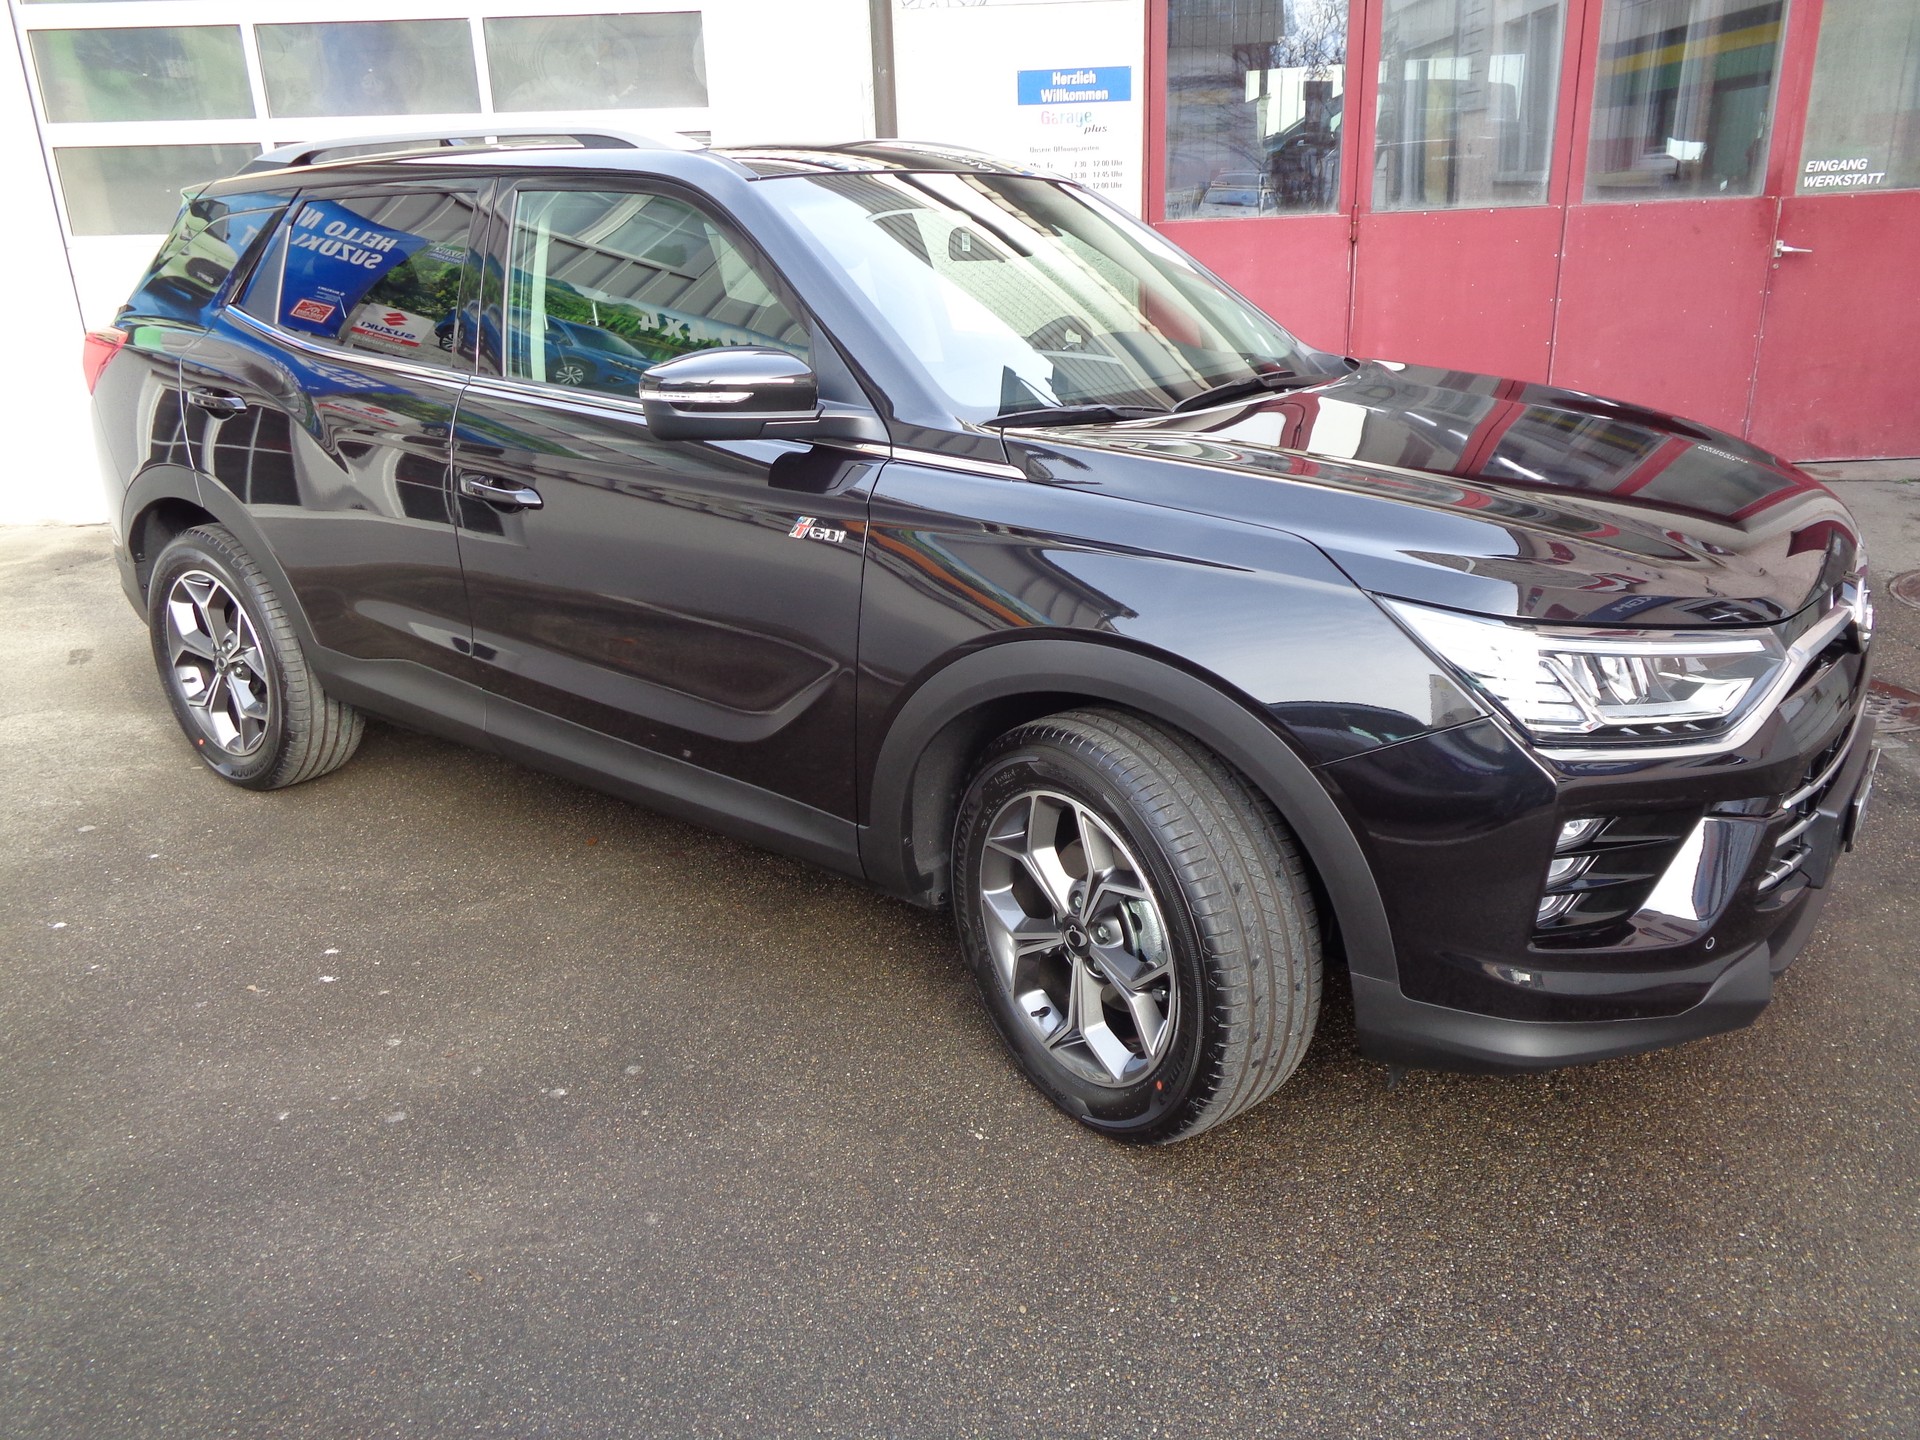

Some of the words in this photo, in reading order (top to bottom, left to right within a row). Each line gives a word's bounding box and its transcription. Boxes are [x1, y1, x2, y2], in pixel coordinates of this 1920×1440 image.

[1052, 70, 1096, 86] Herzlich
[1040, 88, 1109, 103] Willkommen
[1041, 110, 1093, 128] Garage
[1084, 124, 1108, 135] plus
[1805, 158, 1868, 173] EINGANG
[1803, 172, 1885, 188] WERKSTATT
